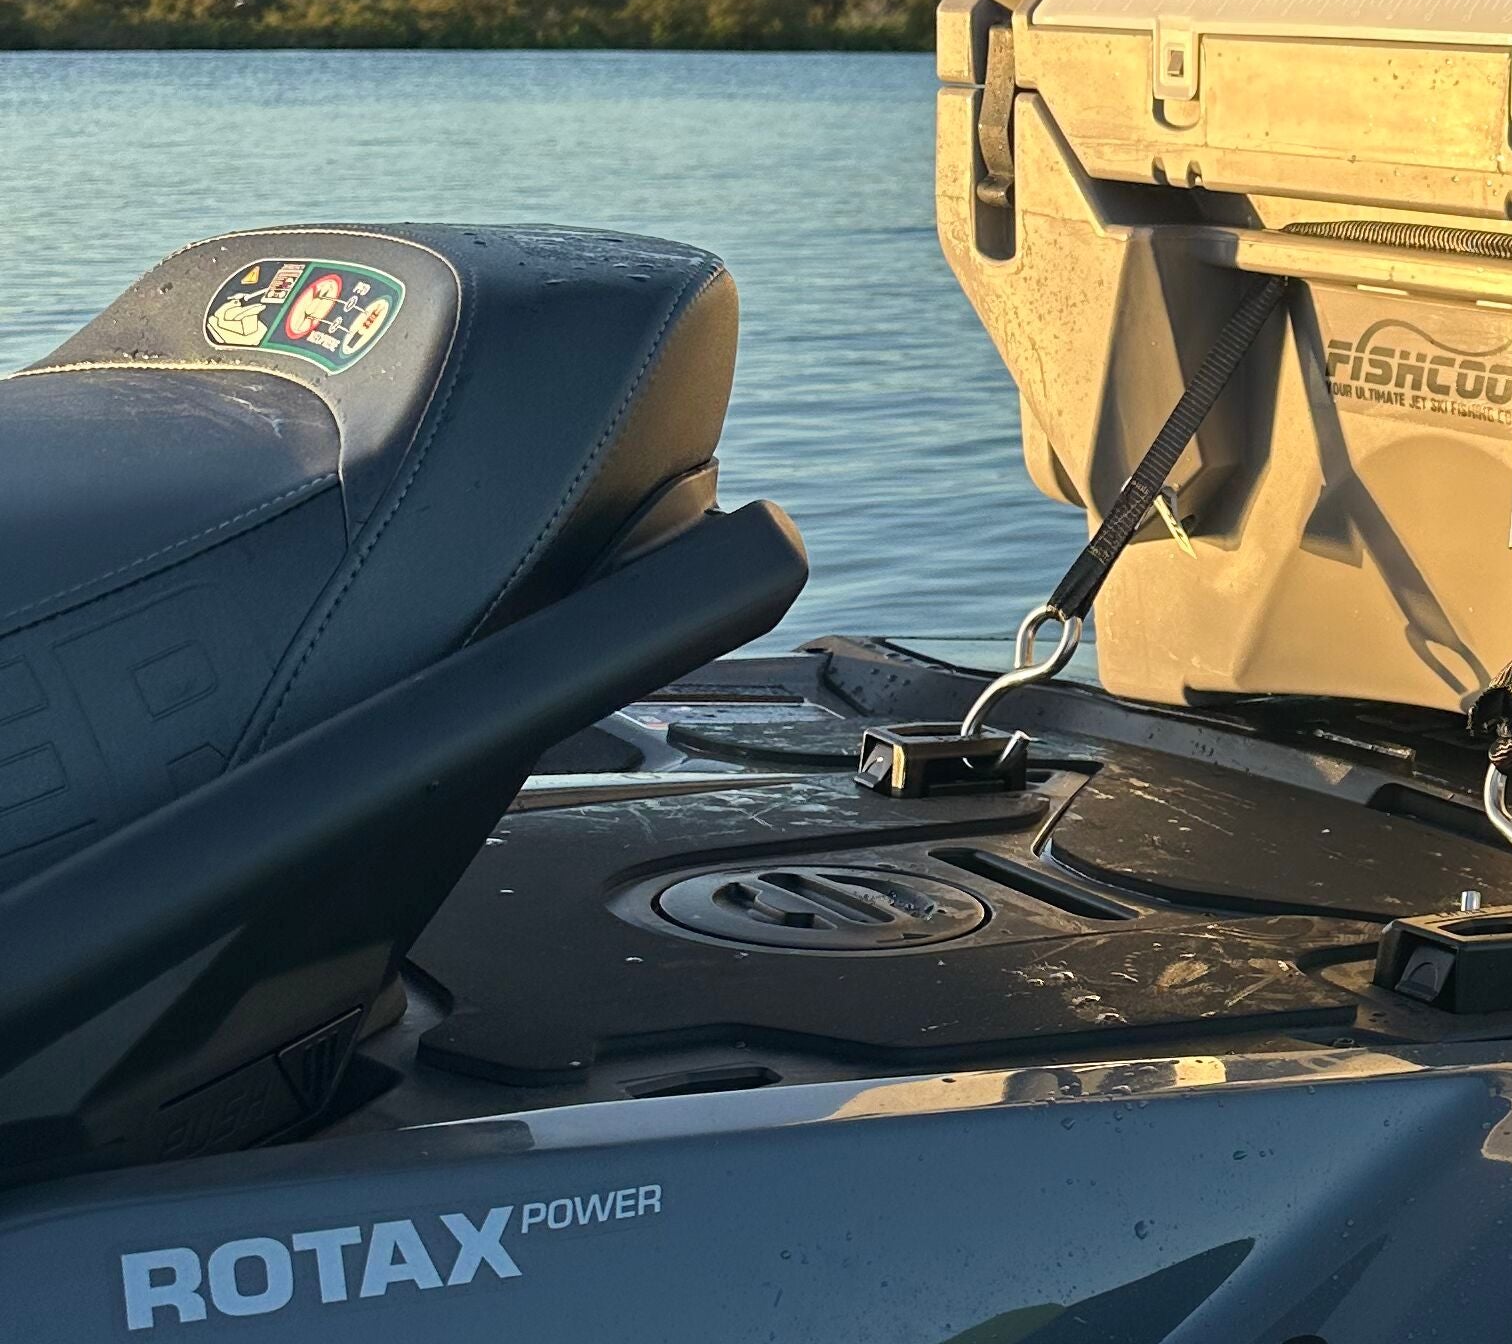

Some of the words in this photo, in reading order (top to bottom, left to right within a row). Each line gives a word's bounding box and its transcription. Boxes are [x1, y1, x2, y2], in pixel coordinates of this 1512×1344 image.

[1355, 385, 1405, 407] ULTIMATE
[1409, 394, 1427, 410] JET
[1431, 398, 1447, 414] SKI
[121, 1205, 523, 1331] ROTAX
[521, 1184, 662, 1234] POWER
